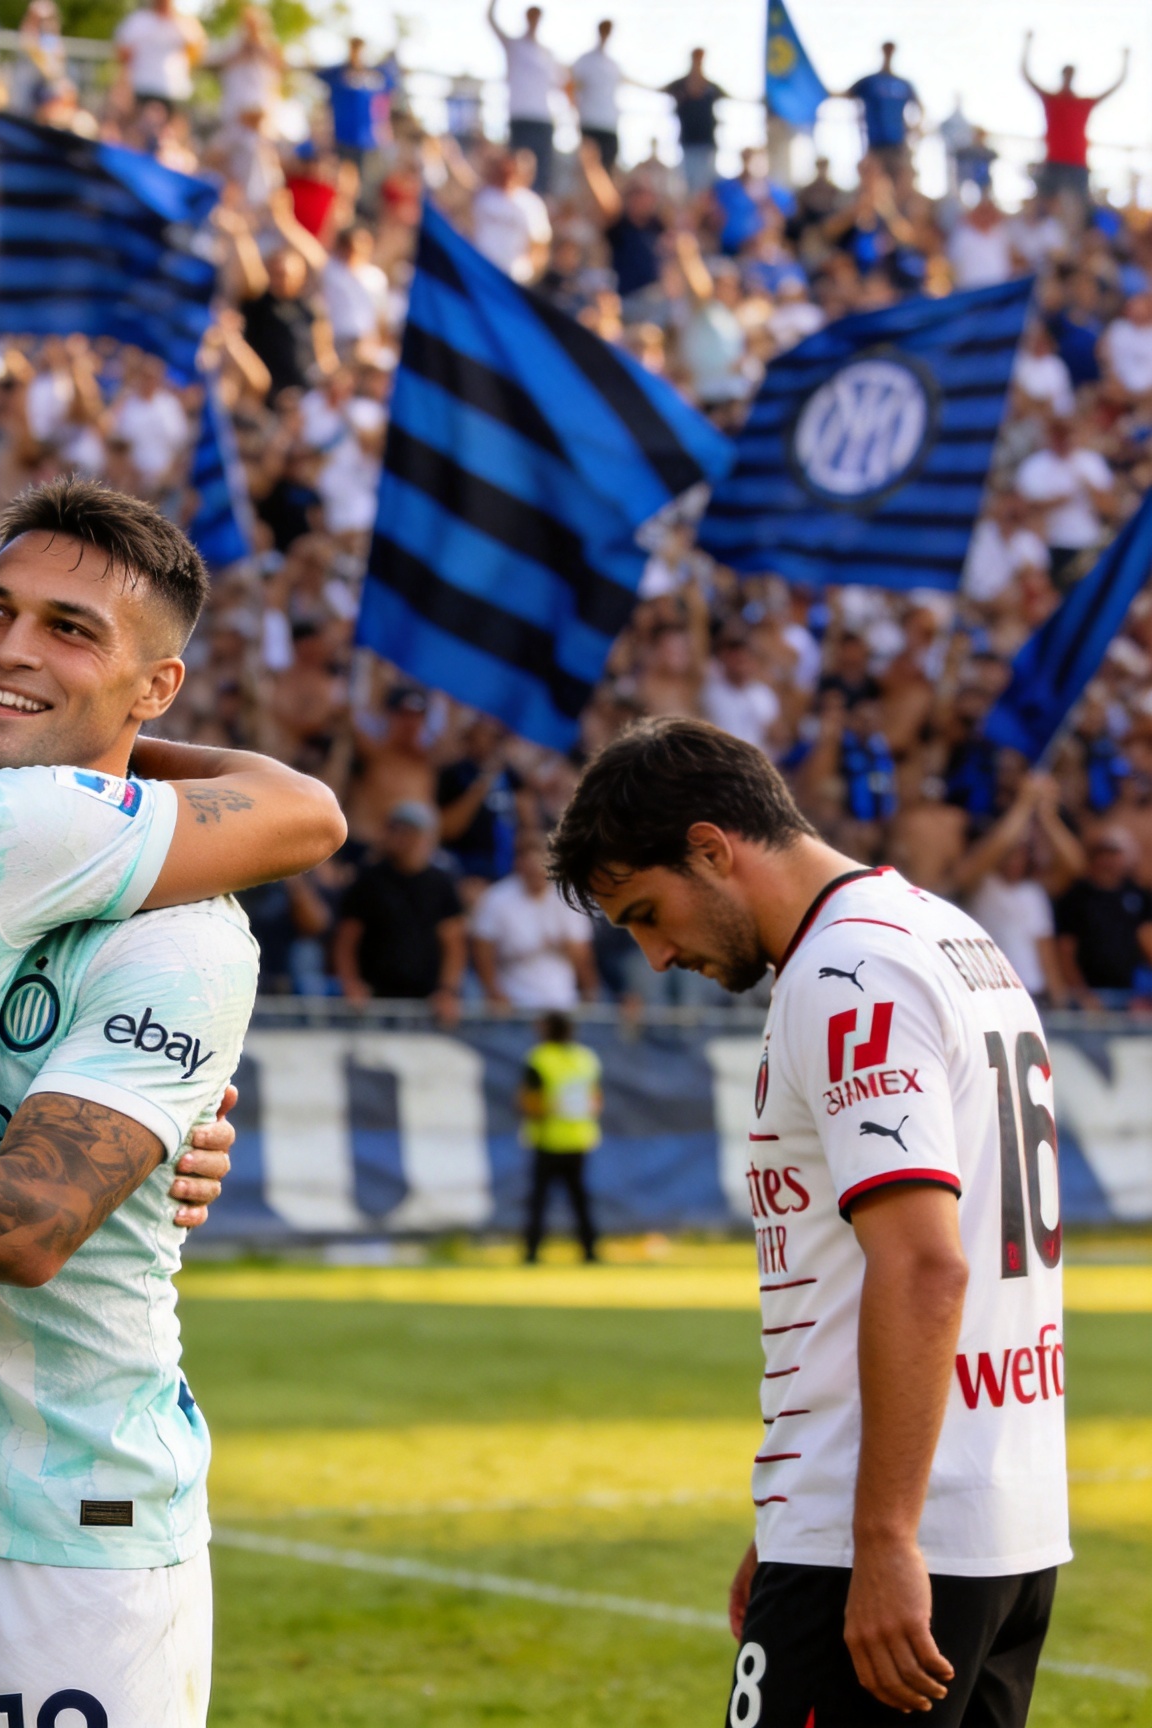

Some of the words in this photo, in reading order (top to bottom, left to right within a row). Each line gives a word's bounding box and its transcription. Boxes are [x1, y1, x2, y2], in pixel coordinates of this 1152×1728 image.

[103, 1007, 217, 1080] ebay
[983, 1030, 1062, 1280] 16
[729, 1641, 767, 1728] 8
